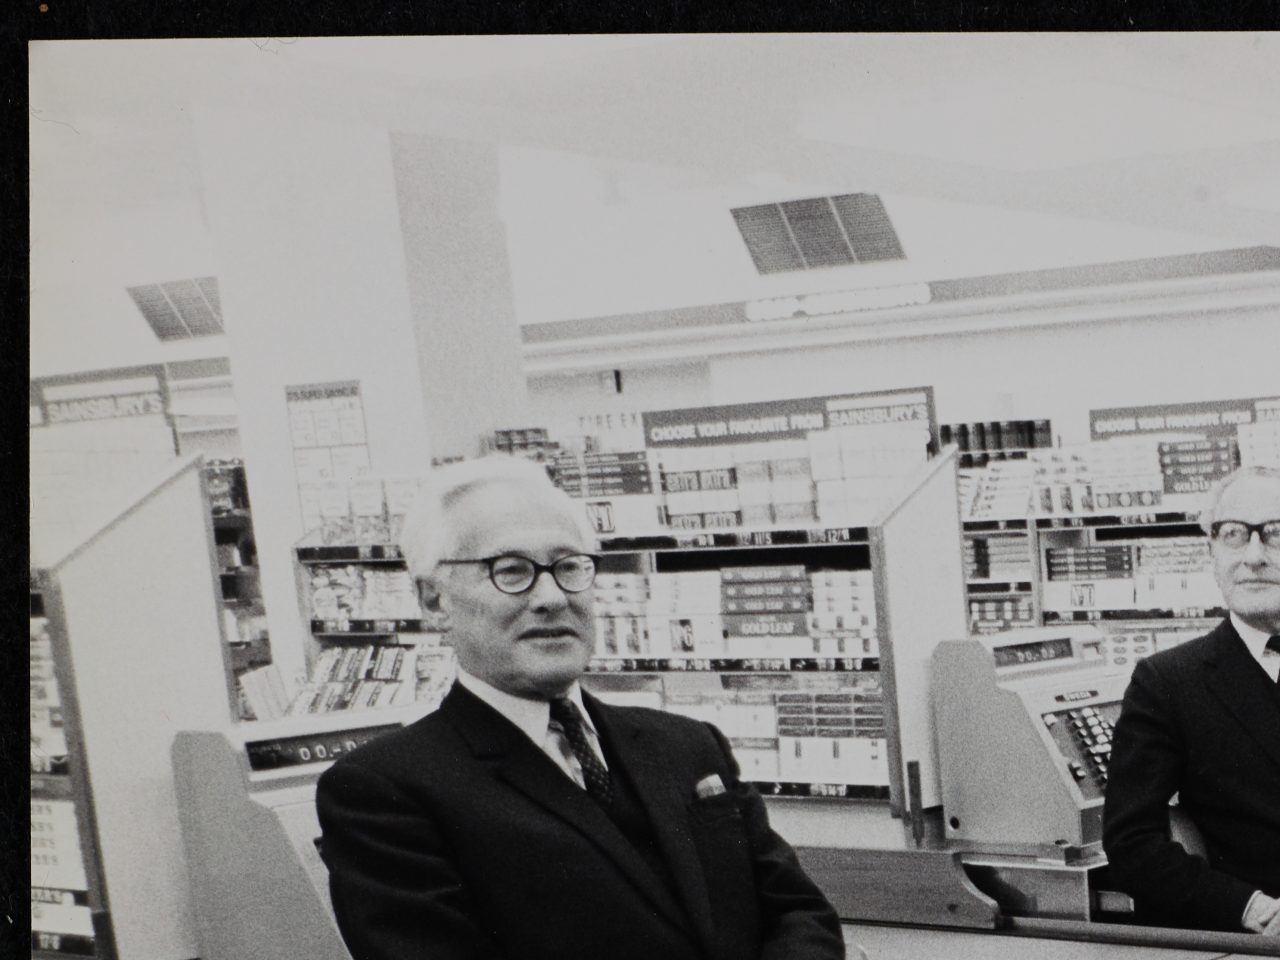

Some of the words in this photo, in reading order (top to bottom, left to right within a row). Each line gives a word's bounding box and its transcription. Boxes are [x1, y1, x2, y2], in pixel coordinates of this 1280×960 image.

[48, 393, 163, 423] SAINSBURY'S
[651, 424, 697, 441] CHOOSE
[698, 422, 727, 437] YOUR
[730, 417, 788, 434] FAVOURITE
[791, 414, 823, 429] FROM
[829, 404, 927, 427] SAINSBURY'S
[741, 622, 769, 635] GOLD
[770, 621, 795, 634] LEAF
